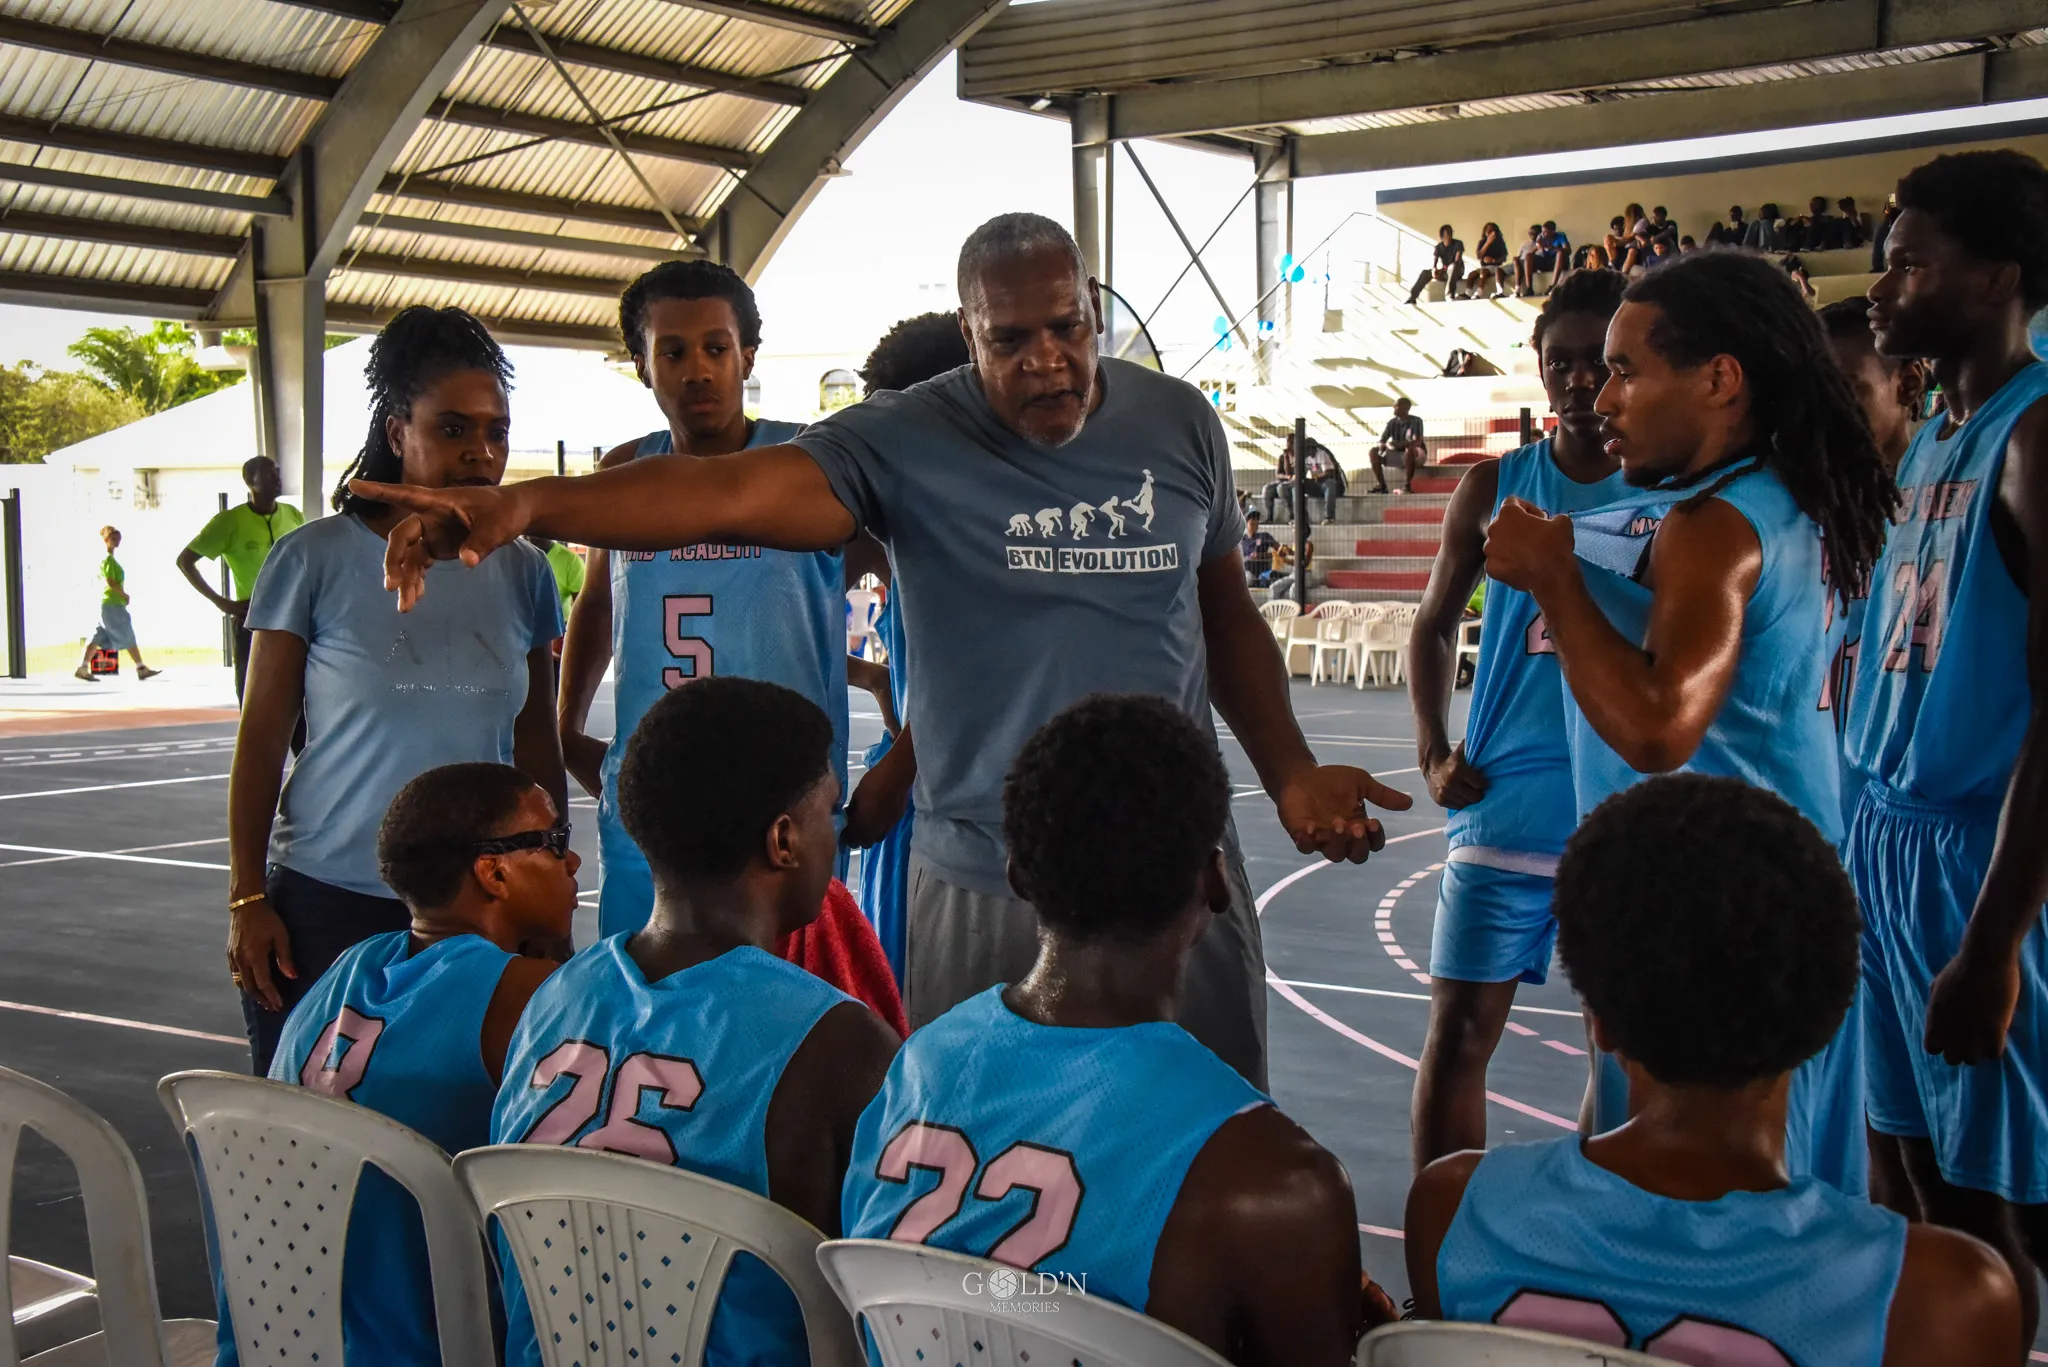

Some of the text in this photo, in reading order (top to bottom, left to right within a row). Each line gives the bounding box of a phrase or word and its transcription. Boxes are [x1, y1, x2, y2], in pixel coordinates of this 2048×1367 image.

[1059, 547, 1177, 571] EVOLUTION
[662, 594, 714, 690] 5
[1884, 558, 1946, 673] 24
[874, 1117, 1086, 1272] 22
